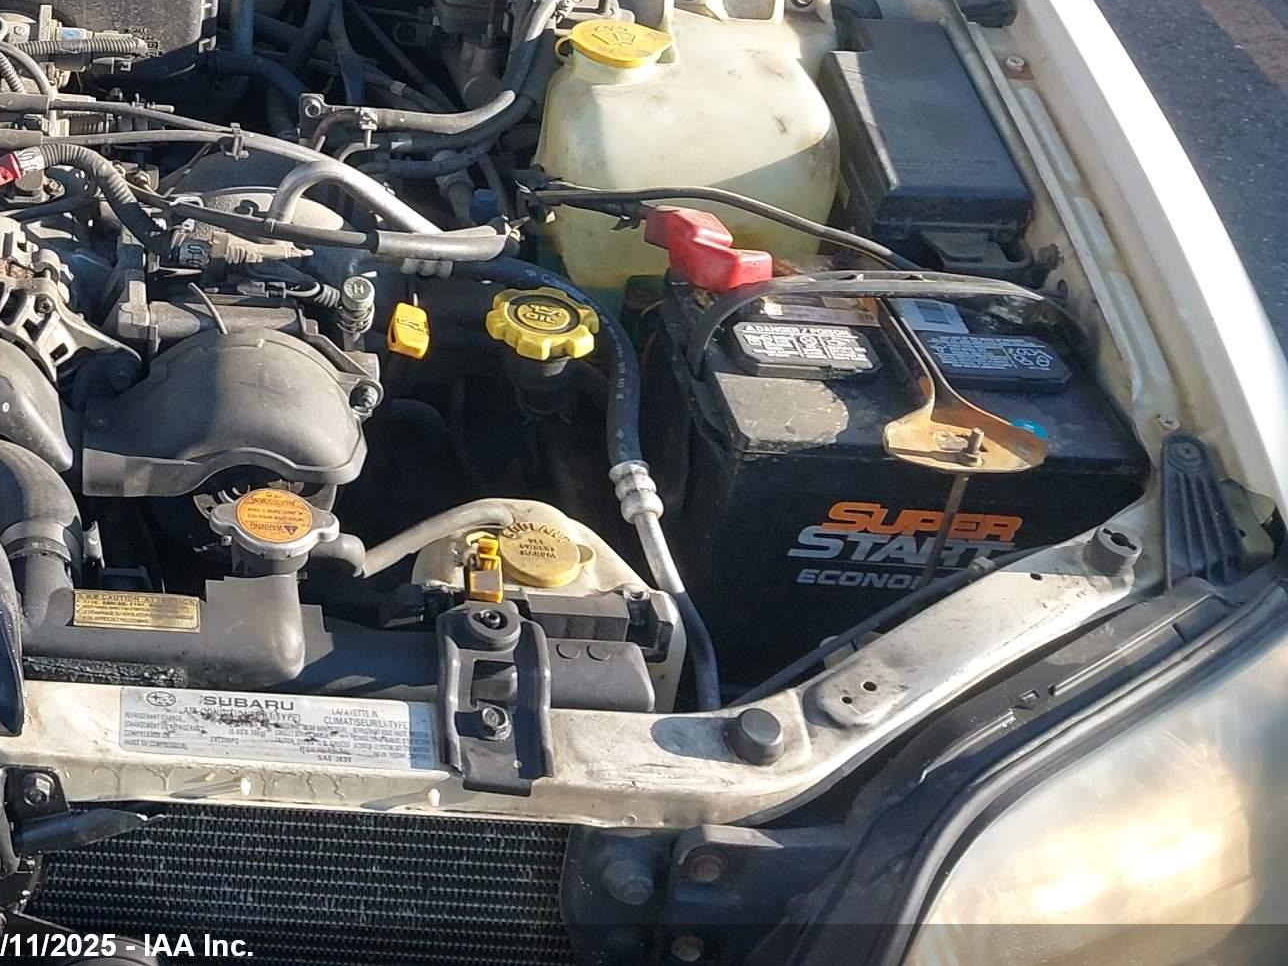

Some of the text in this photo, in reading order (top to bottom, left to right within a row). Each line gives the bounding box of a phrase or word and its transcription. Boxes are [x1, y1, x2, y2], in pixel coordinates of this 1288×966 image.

[524, 311, 556, 324] OIL
[822, 501, 1023, 543] SUPER
[787, 525, 1015, 566] START
[203, 695, 294, 711] SUBARU
